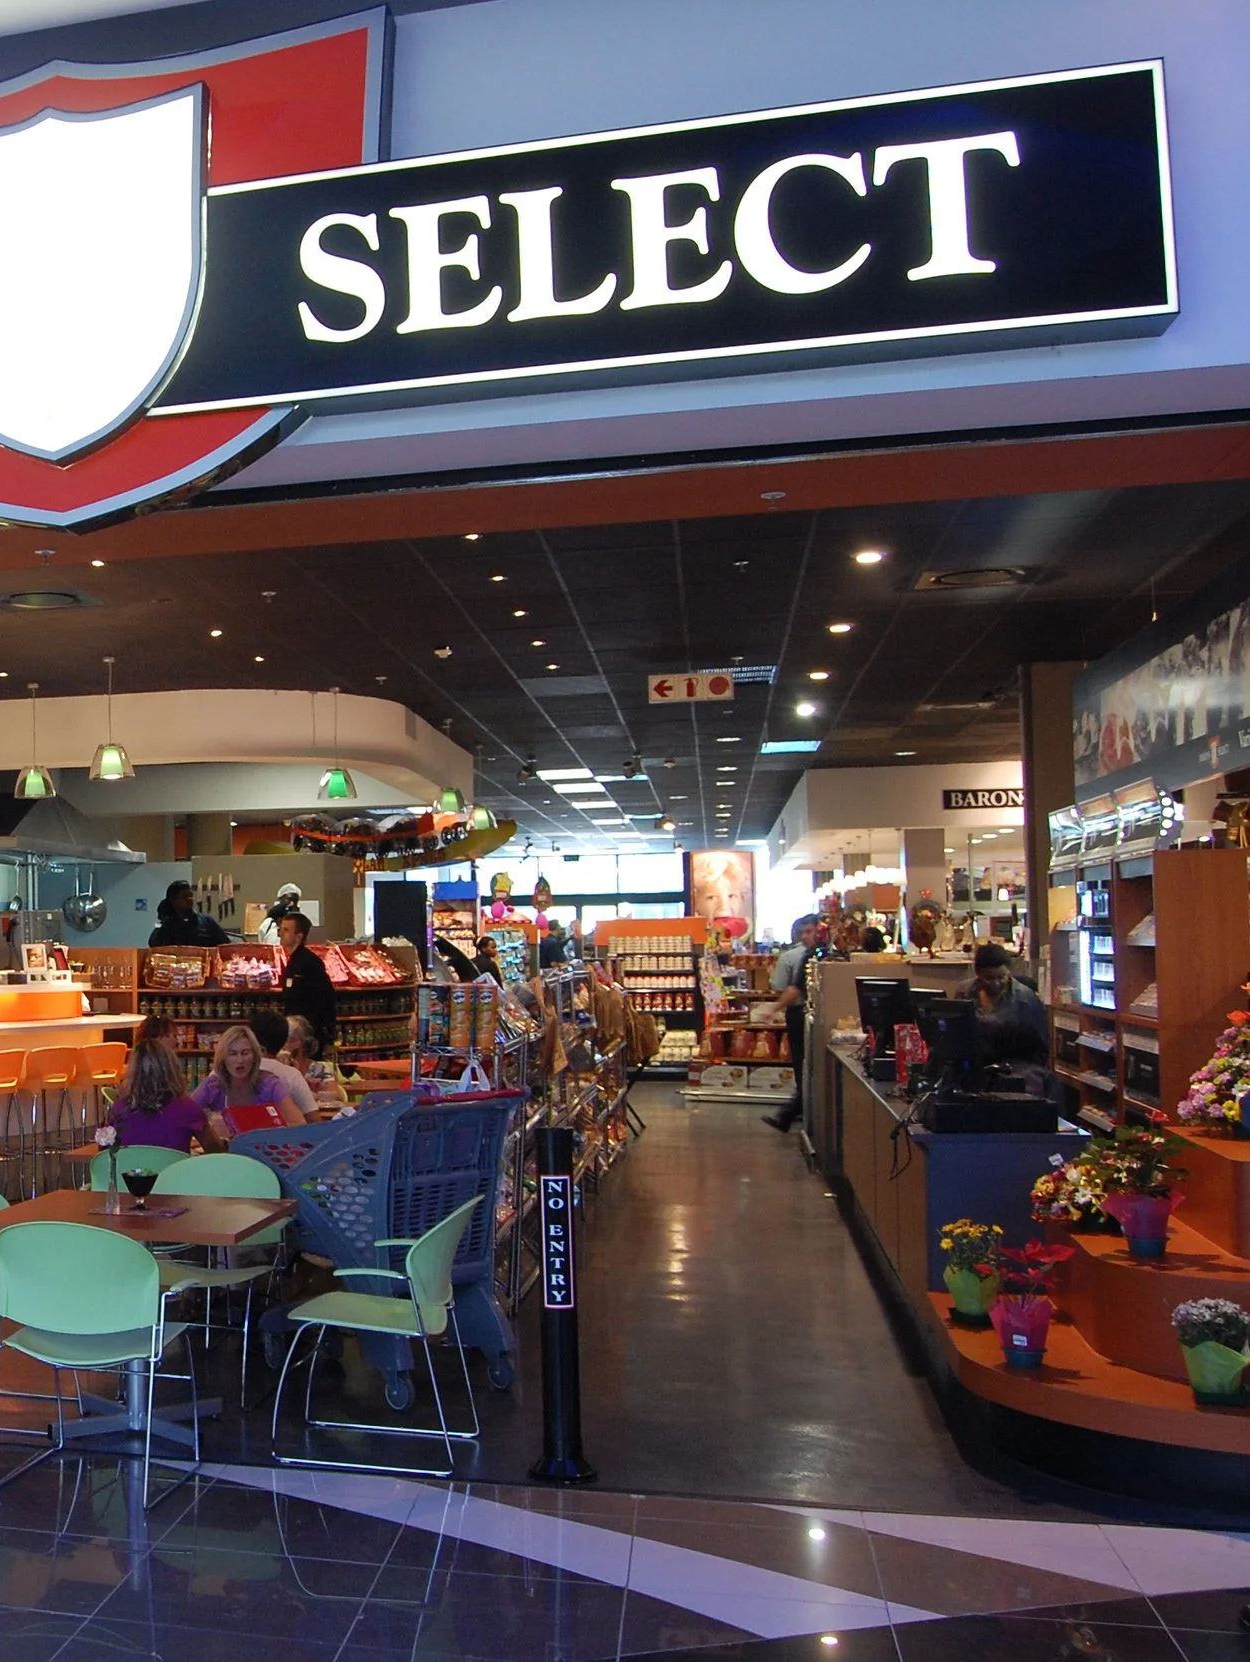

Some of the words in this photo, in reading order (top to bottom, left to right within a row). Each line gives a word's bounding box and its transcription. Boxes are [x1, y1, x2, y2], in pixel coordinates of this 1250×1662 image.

[298, 131, 1021, 343] SELECT
[950, 789, 1025, 807] BARON
[547, 1181, 565, 1210] NO
[549, 1224, 567, 1302] ENTRY
